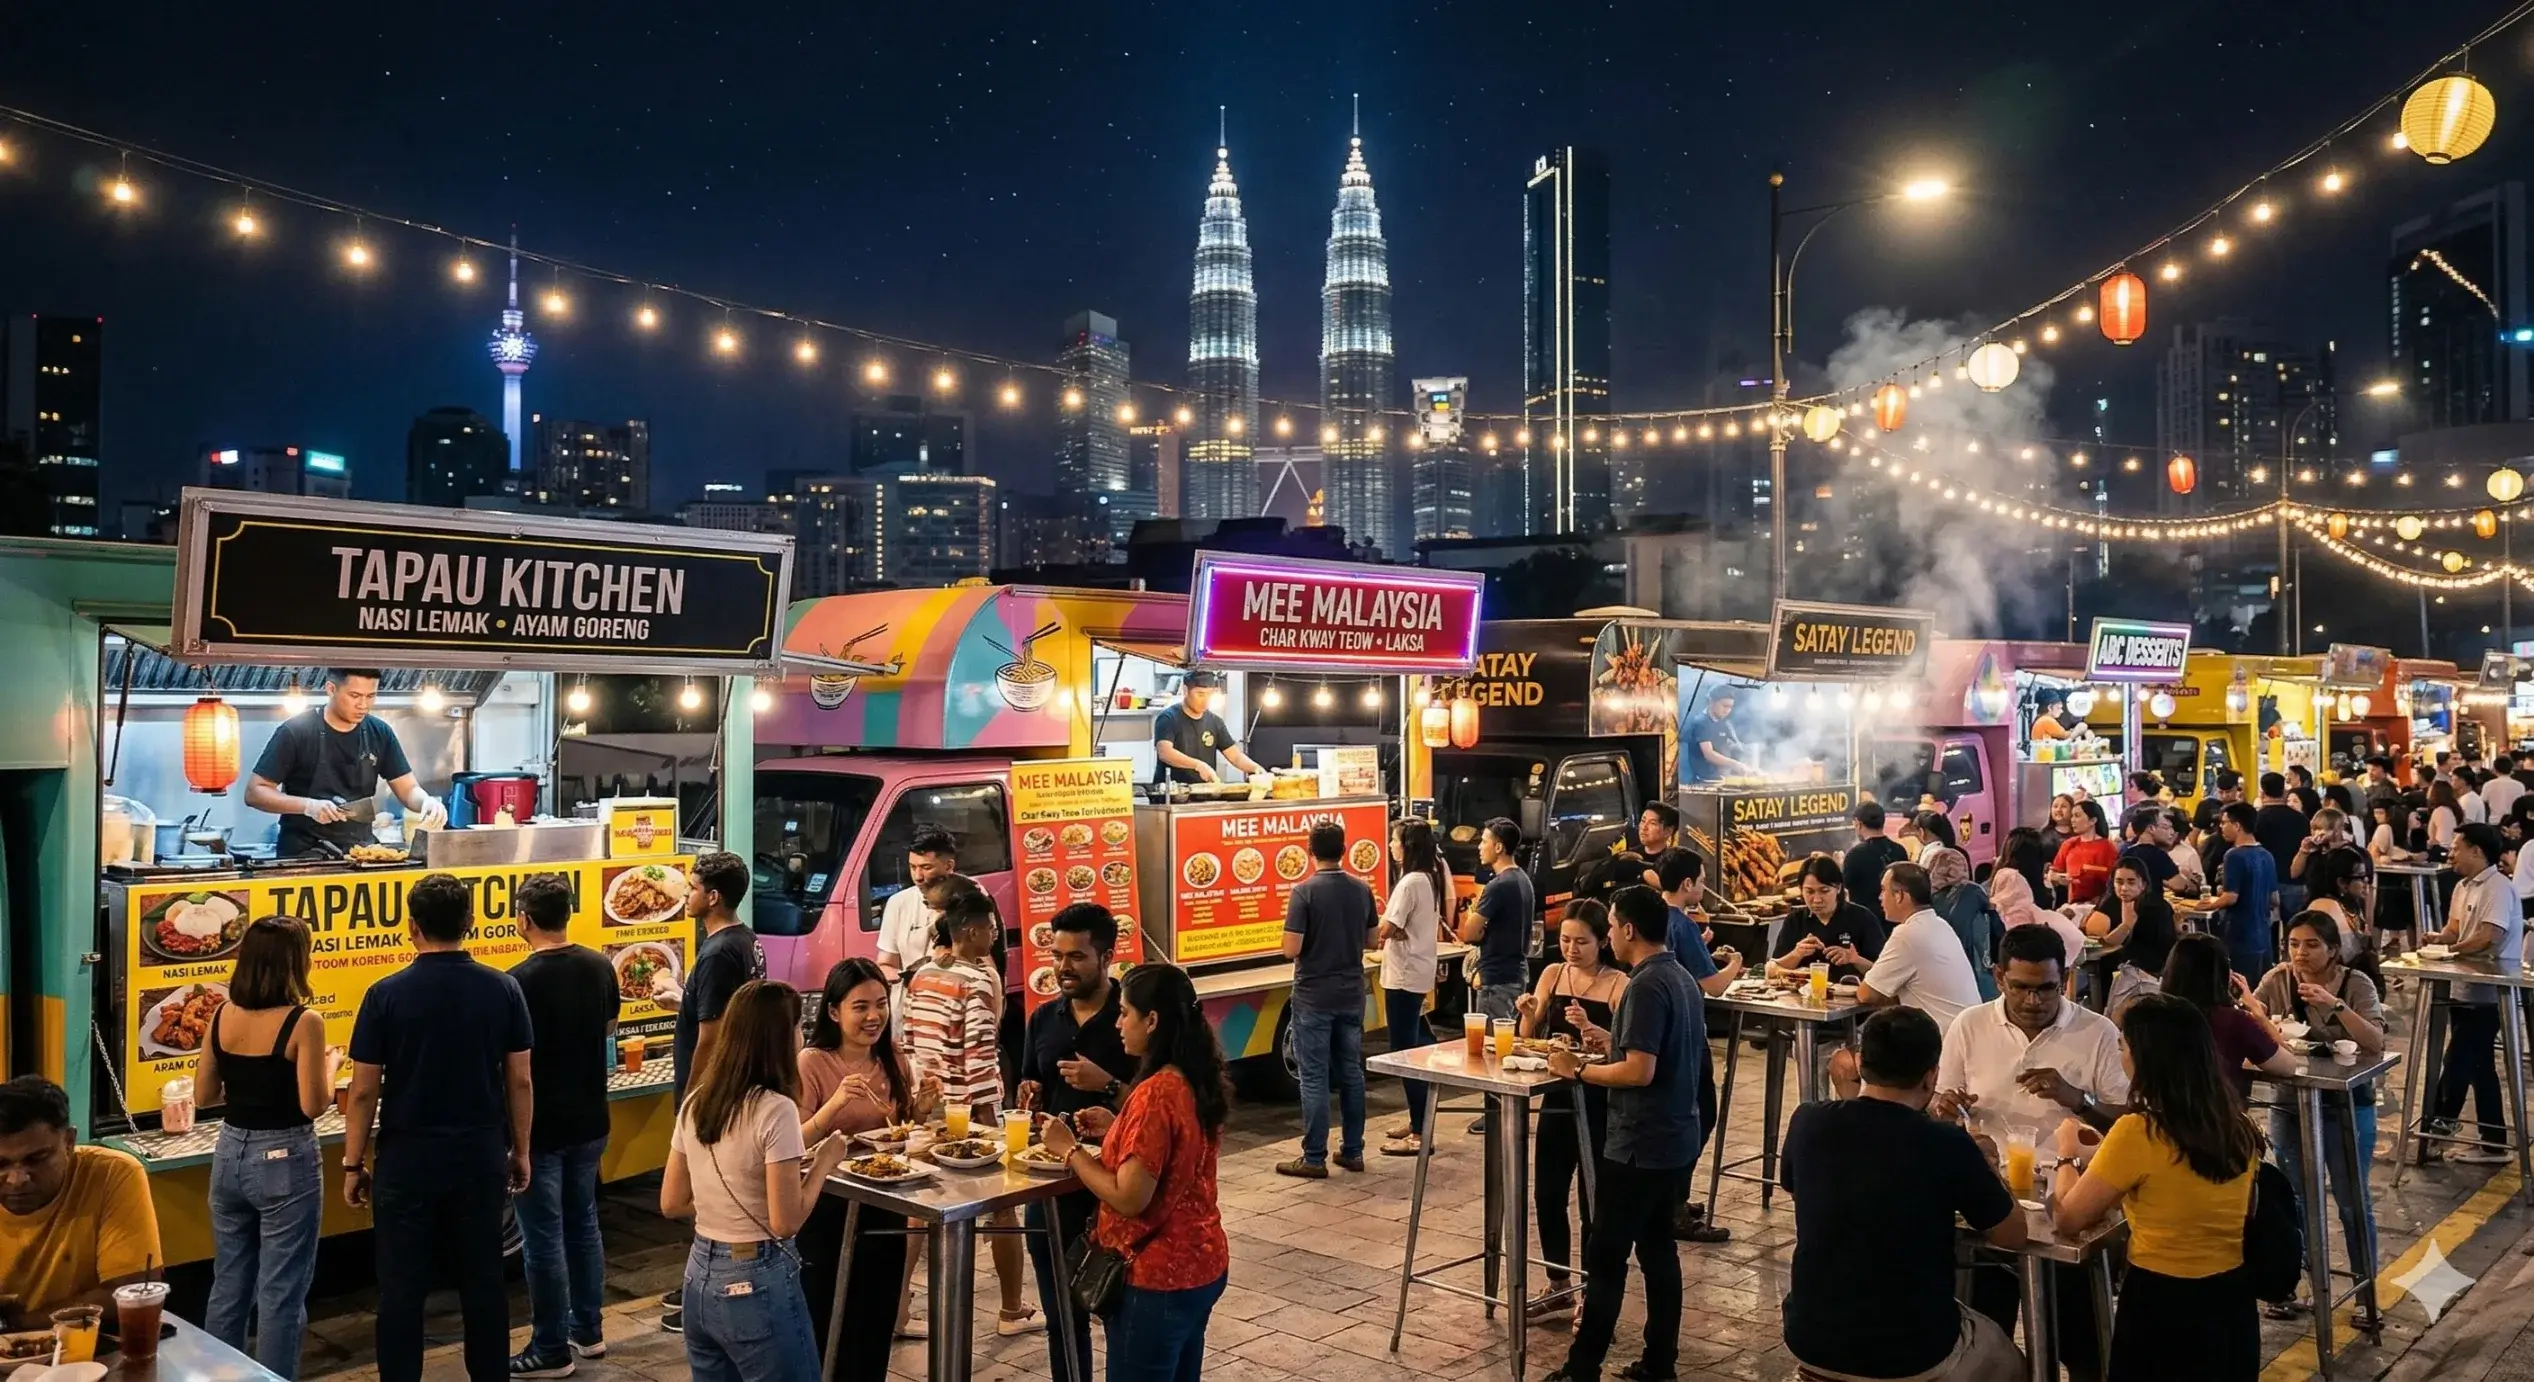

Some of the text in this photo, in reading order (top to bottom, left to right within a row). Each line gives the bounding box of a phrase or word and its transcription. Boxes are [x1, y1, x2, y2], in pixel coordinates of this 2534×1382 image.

[332, 546, 685, 615] TAPAU KITCHEN
[1243, 580, 1442, 631] MEE MALAYSIA
[359, 606, 650, 641] NASI LEMAK AYAM GORENG
[1260, 627, 1425, 652] CHAR KWAY TEOW LAKSA
[1793, 622, 1916, 656] SATAY LEGEND
[2097, 634, 2126, 665] ABC
[1443, 652, 1538, 679] ATAY
[1018, 770, 1127, 790] MEE MALAYSIA
[1733, 791, 1849, 822] SATAY LEGEND
[1221, 817, 1259, 838] MEE
[268, 880, 403, 932] TAPAU
[312, 937, 340, 953] ASI
[345, 933, 404, 950] LEMAK
[484, 924, 517, 939] GOR
[163, 964, 228, 979] NASI LEMAK
[351, 953, 396, 967] KORENG
[153, 1060, 185, 1073] ARAM
